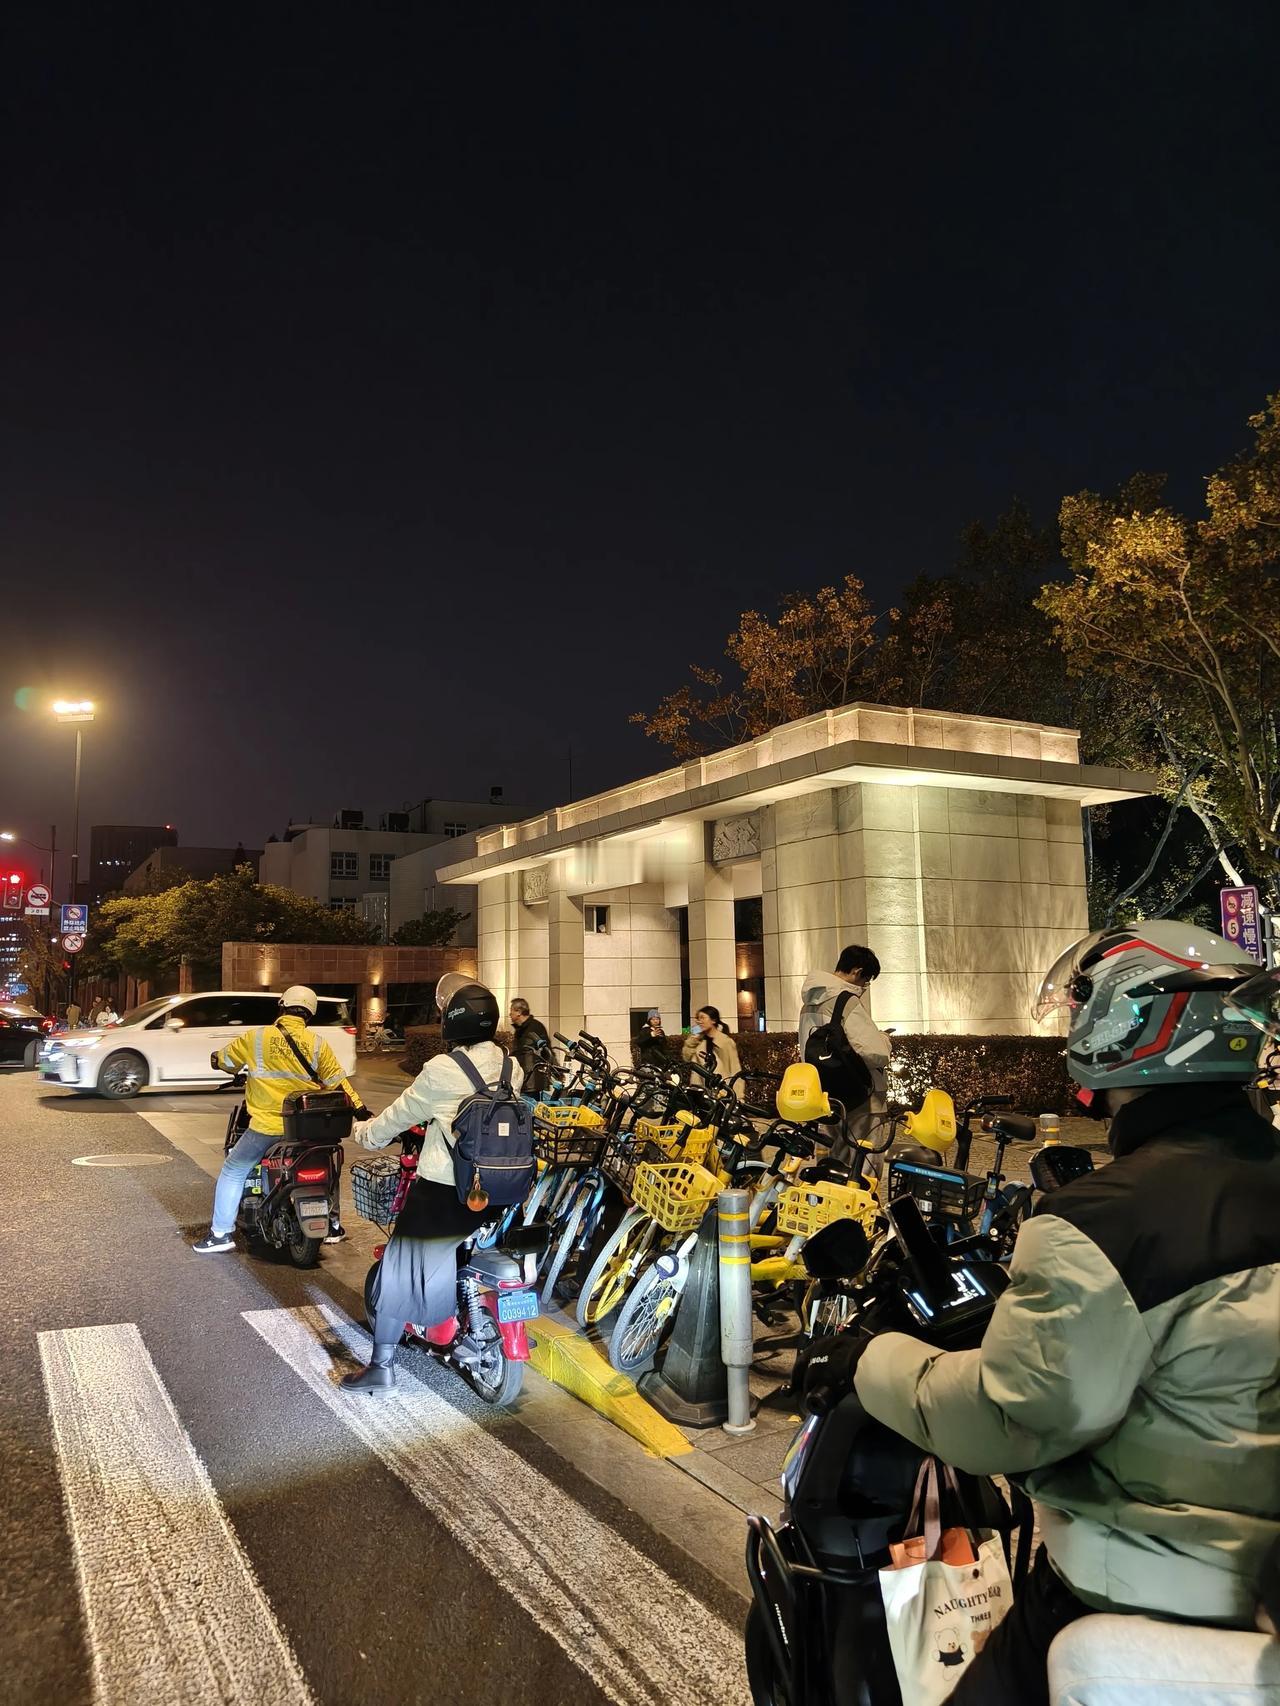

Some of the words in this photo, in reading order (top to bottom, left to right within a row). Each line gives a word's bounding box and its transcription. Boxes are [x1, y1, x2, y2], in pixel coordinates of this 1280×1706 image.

[1230, 922, 1237, 934] 5
[1240, 891, 1257, 960] 减速慢行
[502, 1304, 537, 1321] C039412
[933, 1592, 988, 1619] NAUGHTY
